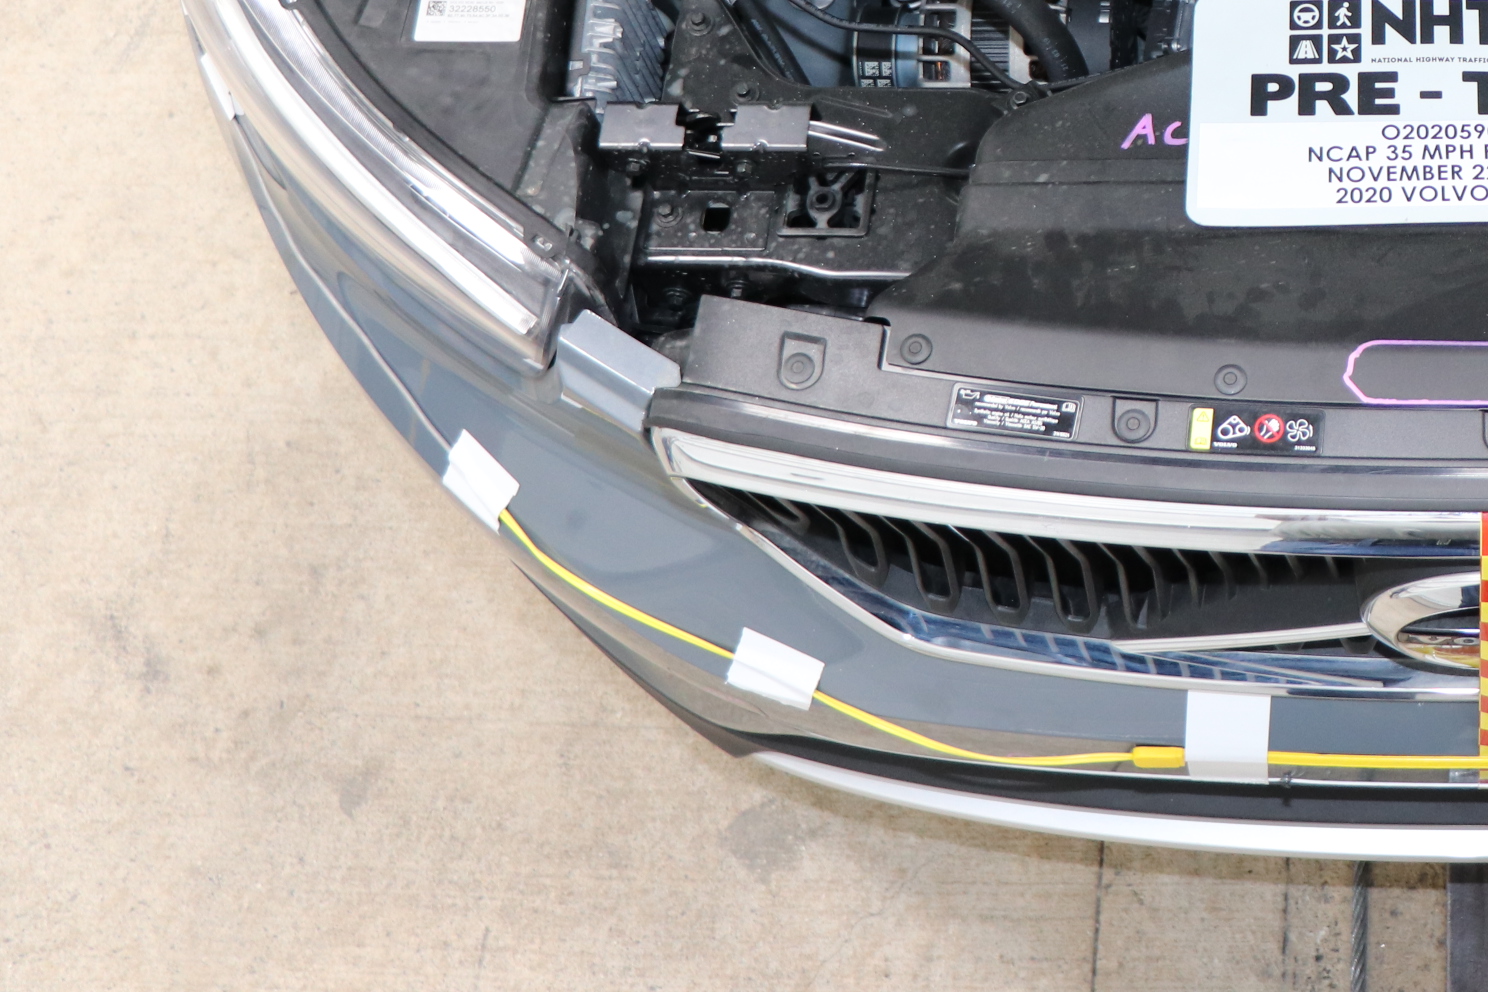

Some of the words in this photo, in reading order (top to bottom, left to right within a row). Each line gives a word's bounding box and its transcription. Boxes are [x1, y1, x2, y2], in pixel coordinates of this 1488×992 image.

[449, 5, 496, 13] 32228550
[1250, 71, 1400, 116] PRE
[1420, 91, 1442, 99] -
[1308, 145, 1377, 162] NCAP
[1386, 145, 1413, 161] 35
[1422, 144, 1473, 160] MPH
[1328, 165, 1463, 183] NOVEMBER
[1336, 186, 1392, 204] 2020
